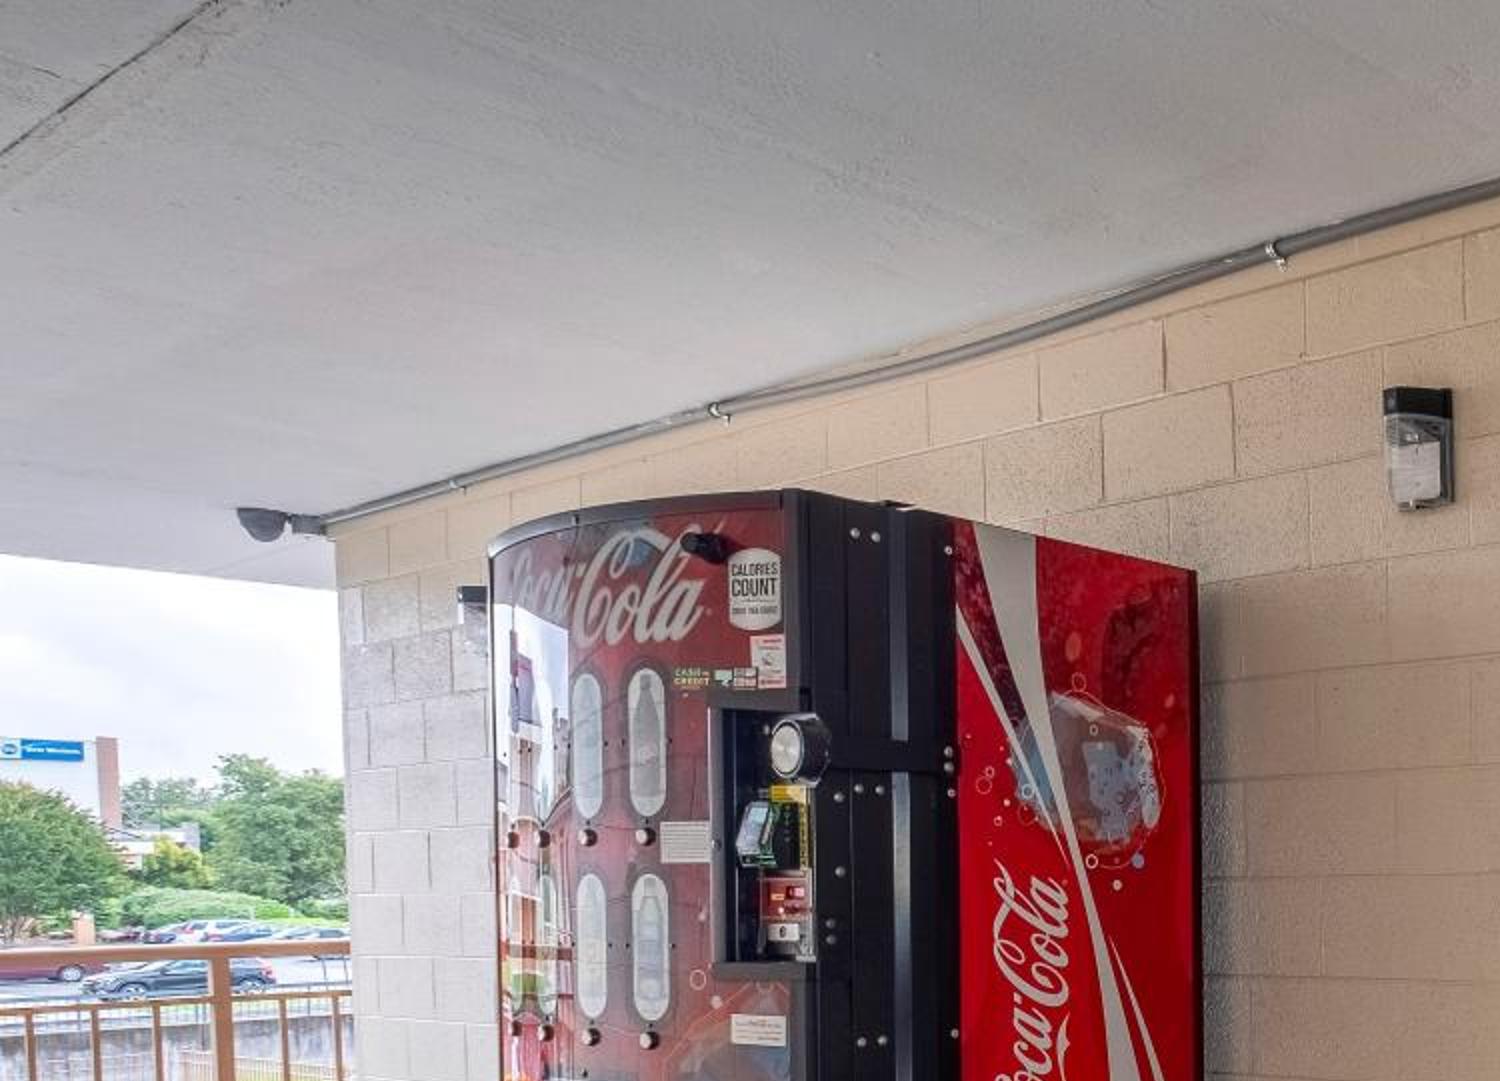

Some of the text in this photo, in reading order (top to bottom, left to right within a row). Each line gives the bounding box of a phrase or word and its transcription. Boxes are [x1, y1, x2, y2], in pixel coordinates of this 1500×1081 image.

[731, 563, 779, 577] CALORIES
[512, 524, 705, 649] Coca-Cola
[731, 577, 778, 597] COUNT
